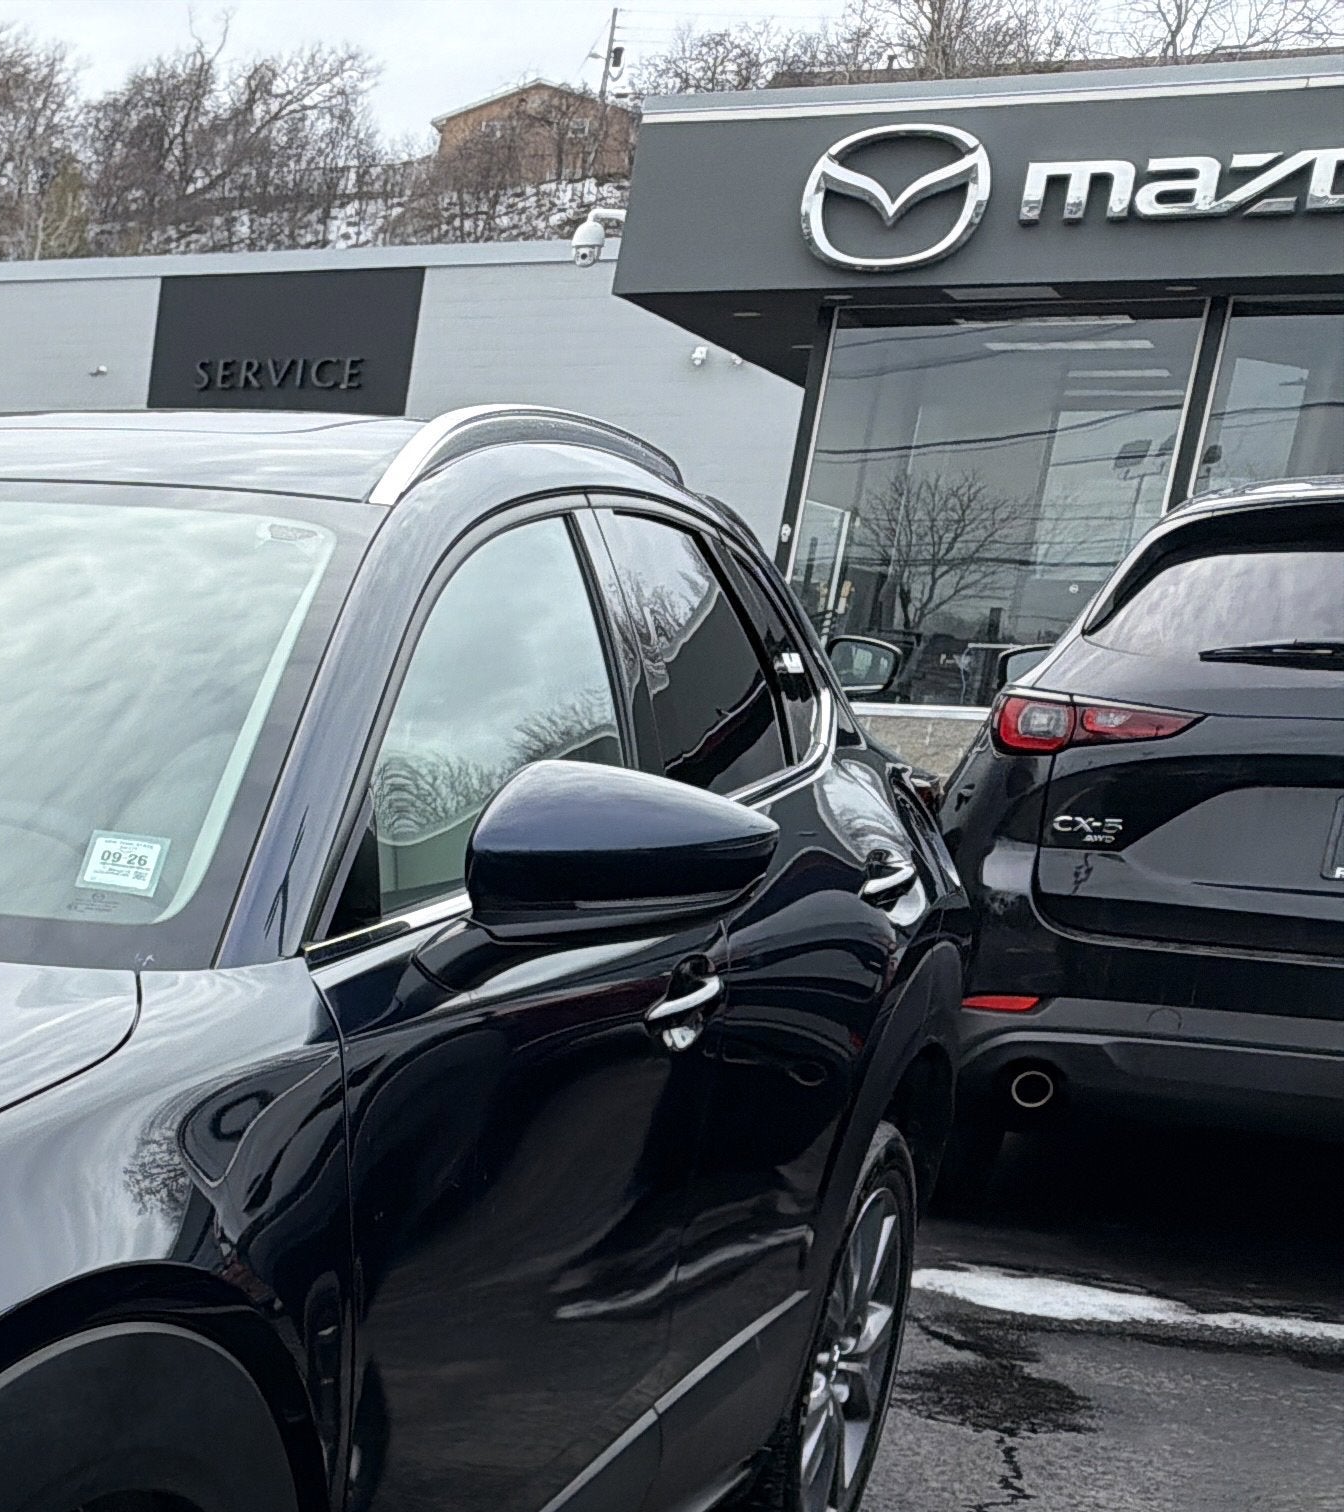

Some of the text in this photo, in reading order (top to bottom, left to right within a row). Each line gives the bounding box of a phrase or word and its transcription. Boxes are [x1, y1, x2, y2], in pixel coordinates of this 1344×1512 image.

[194, 356, 365, 390] SERVICE
[1052, 815, 1123, 834] CX-5
[1082, 834, 1116, 844] AWD
